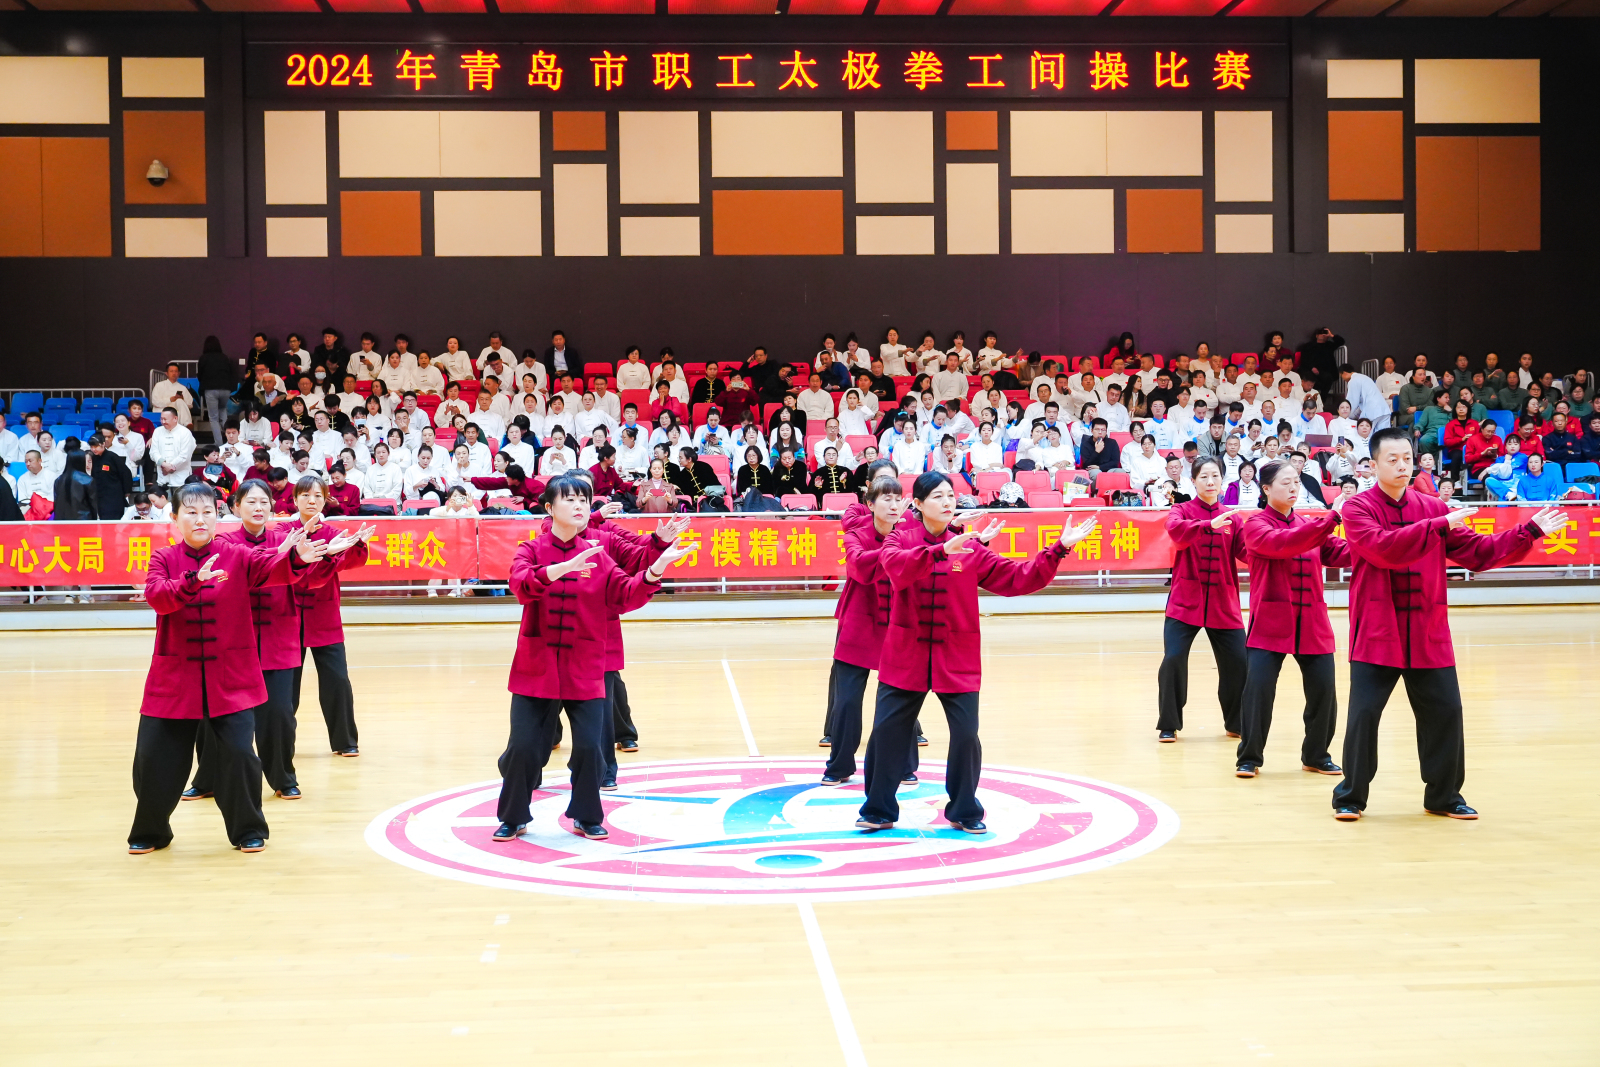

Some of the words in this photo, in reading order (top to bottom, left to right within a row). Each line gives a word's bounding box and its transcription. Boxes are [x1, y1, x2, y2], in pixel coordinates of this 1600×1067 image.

[0, 536, 104, 574] 心大局
[638, 527, 817, 568] 劳模精神
